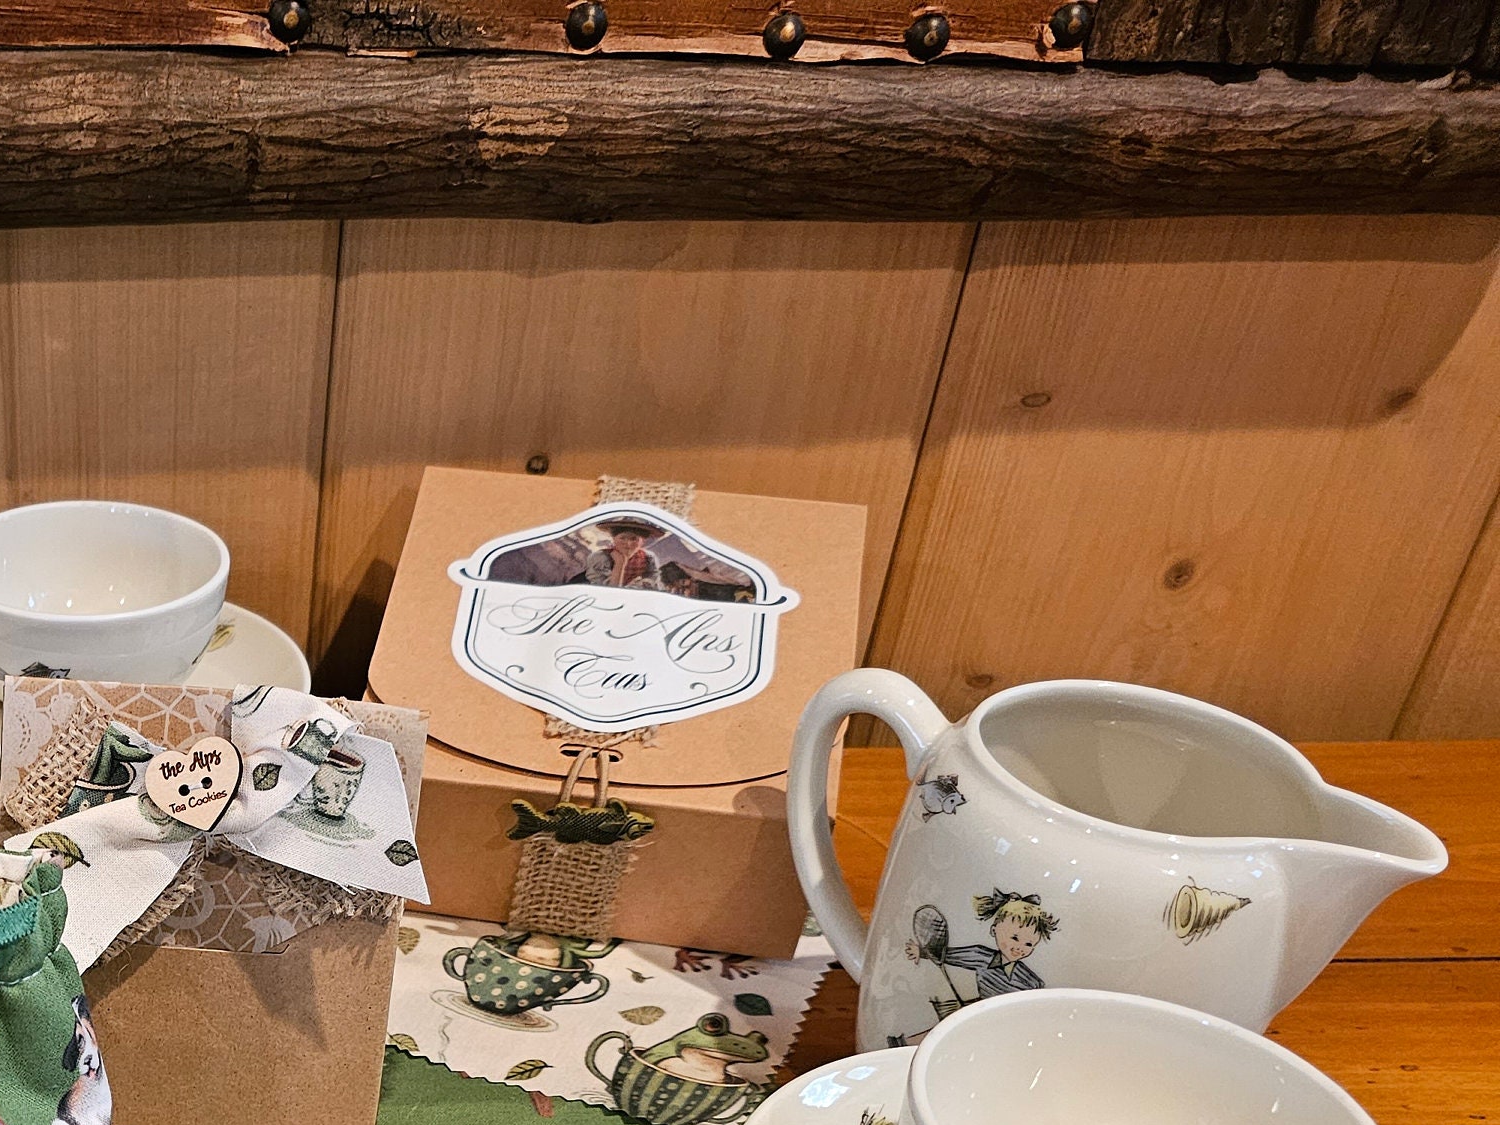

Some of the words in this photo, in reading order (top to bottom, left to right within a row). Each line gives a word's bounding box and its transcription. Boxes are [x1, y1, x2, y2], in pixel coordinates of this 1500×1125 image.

[486, 593, 624, 637] The
[606, 608, 743, 675] Alps
[553, 645, 654, 699] Teas
[159, 761, 185, 780] the
[189, 750, 222, 772] Alps
[169, 803, 187, 814] Tea
[188, 790, 228, 808] Cookies
